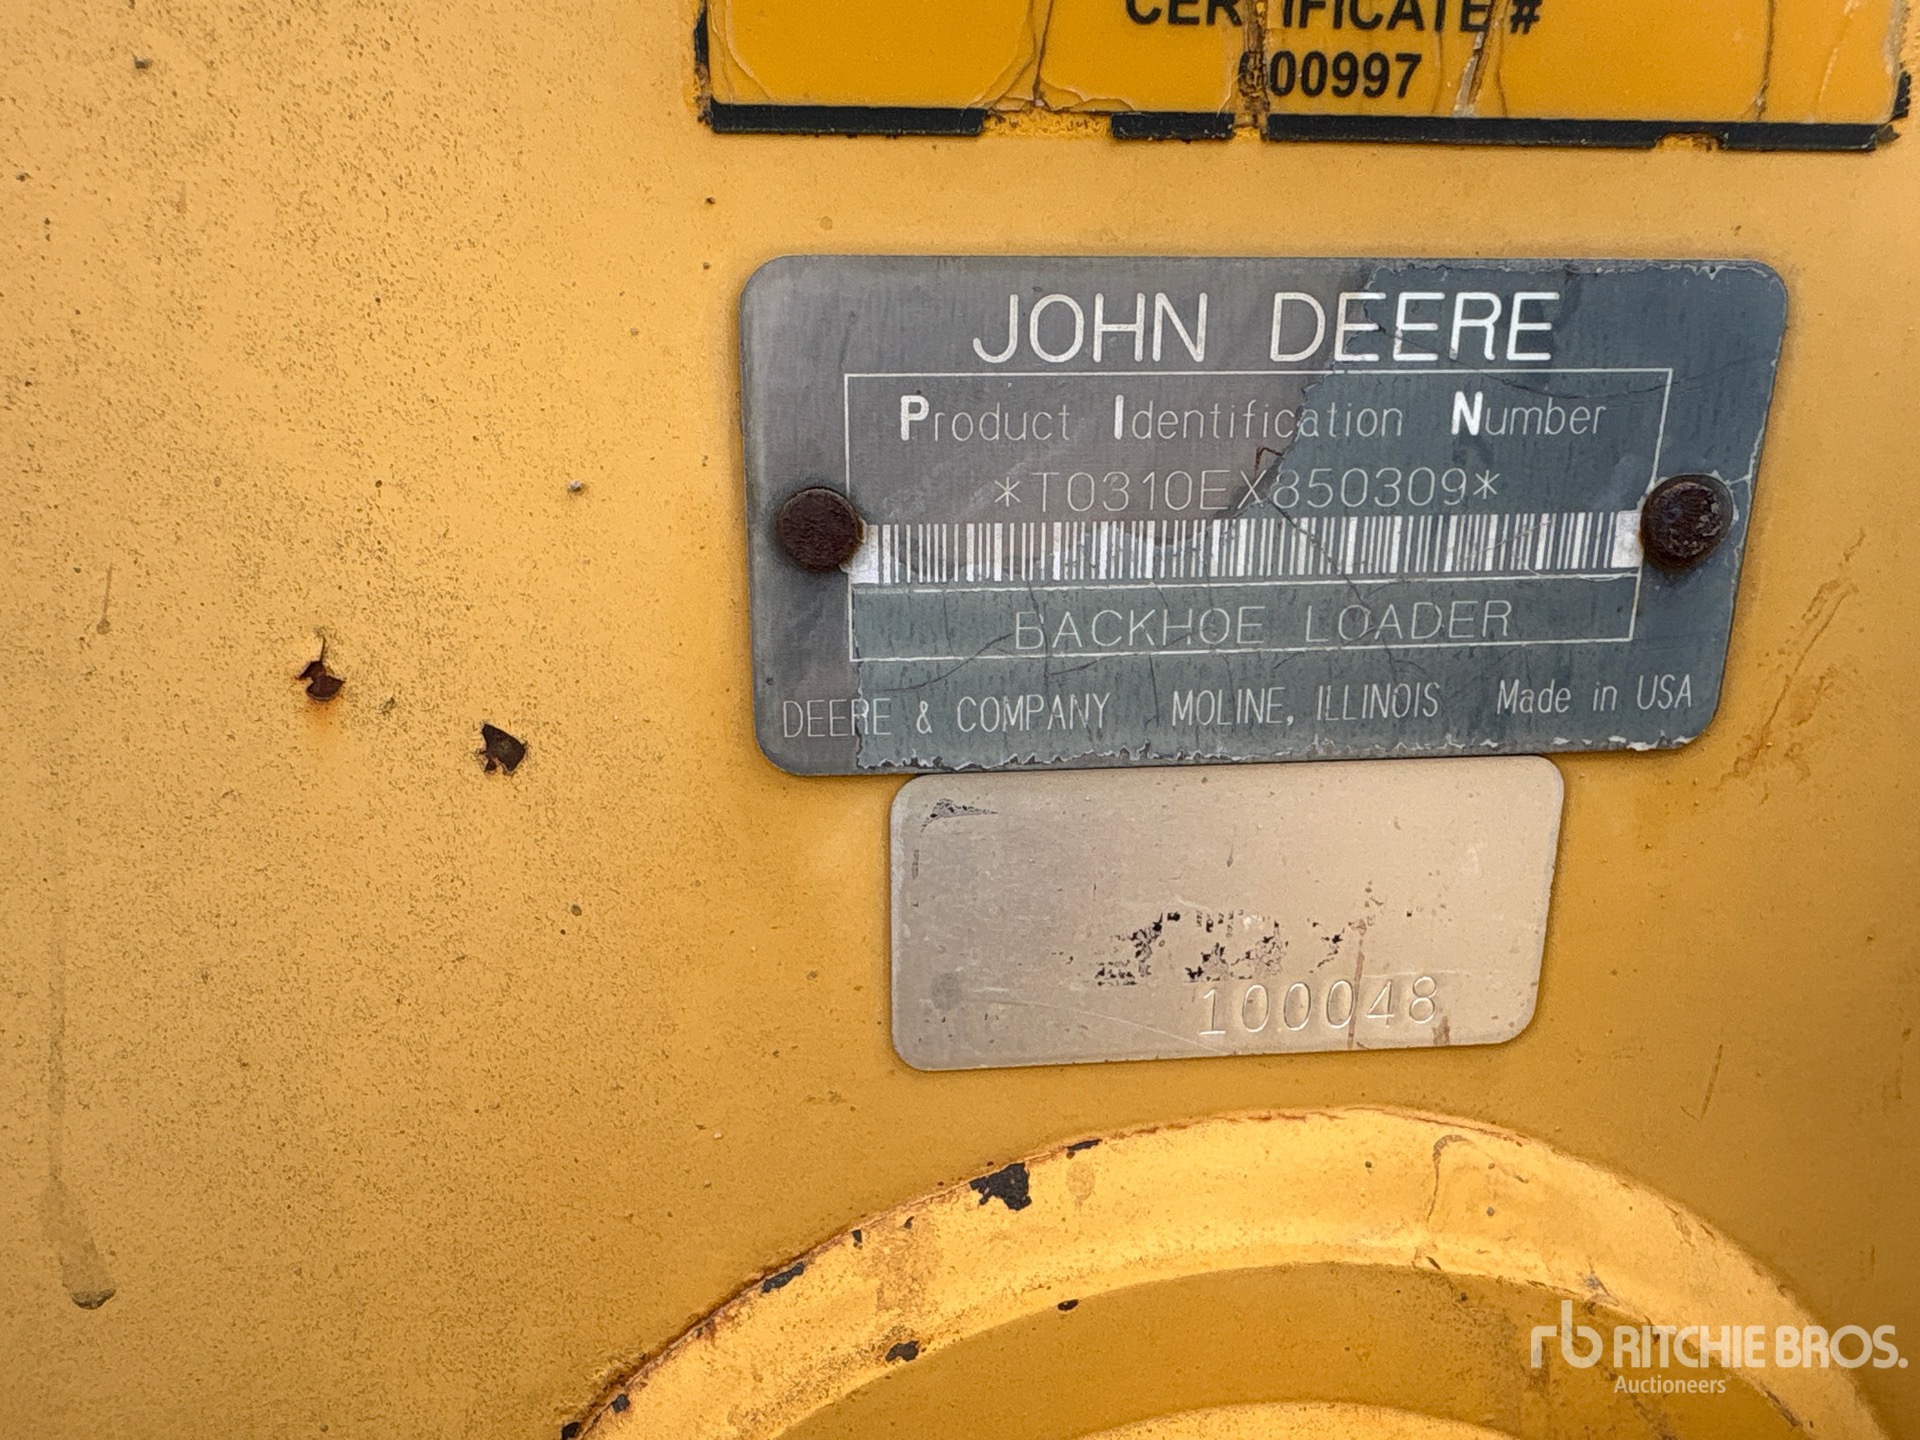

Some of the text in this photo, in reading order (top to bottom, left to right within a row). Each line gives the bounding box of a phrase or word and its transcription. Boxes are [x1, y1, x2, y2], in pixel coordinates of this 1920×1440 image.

[1125, 0, 1491, 32] CERIFICAE
[973, 291, 1560, 364] JOHN DEERE
[900, 390, 1607, 442] Product Identification Number
[1015, 599, 1513, 650] BACKHOE LOADER
[782, 673, 1694, 739] DEERE & COMPANY MOLINE, ILLINOIS Made in USA
[1199, 975, 1438, 1037] 100048
